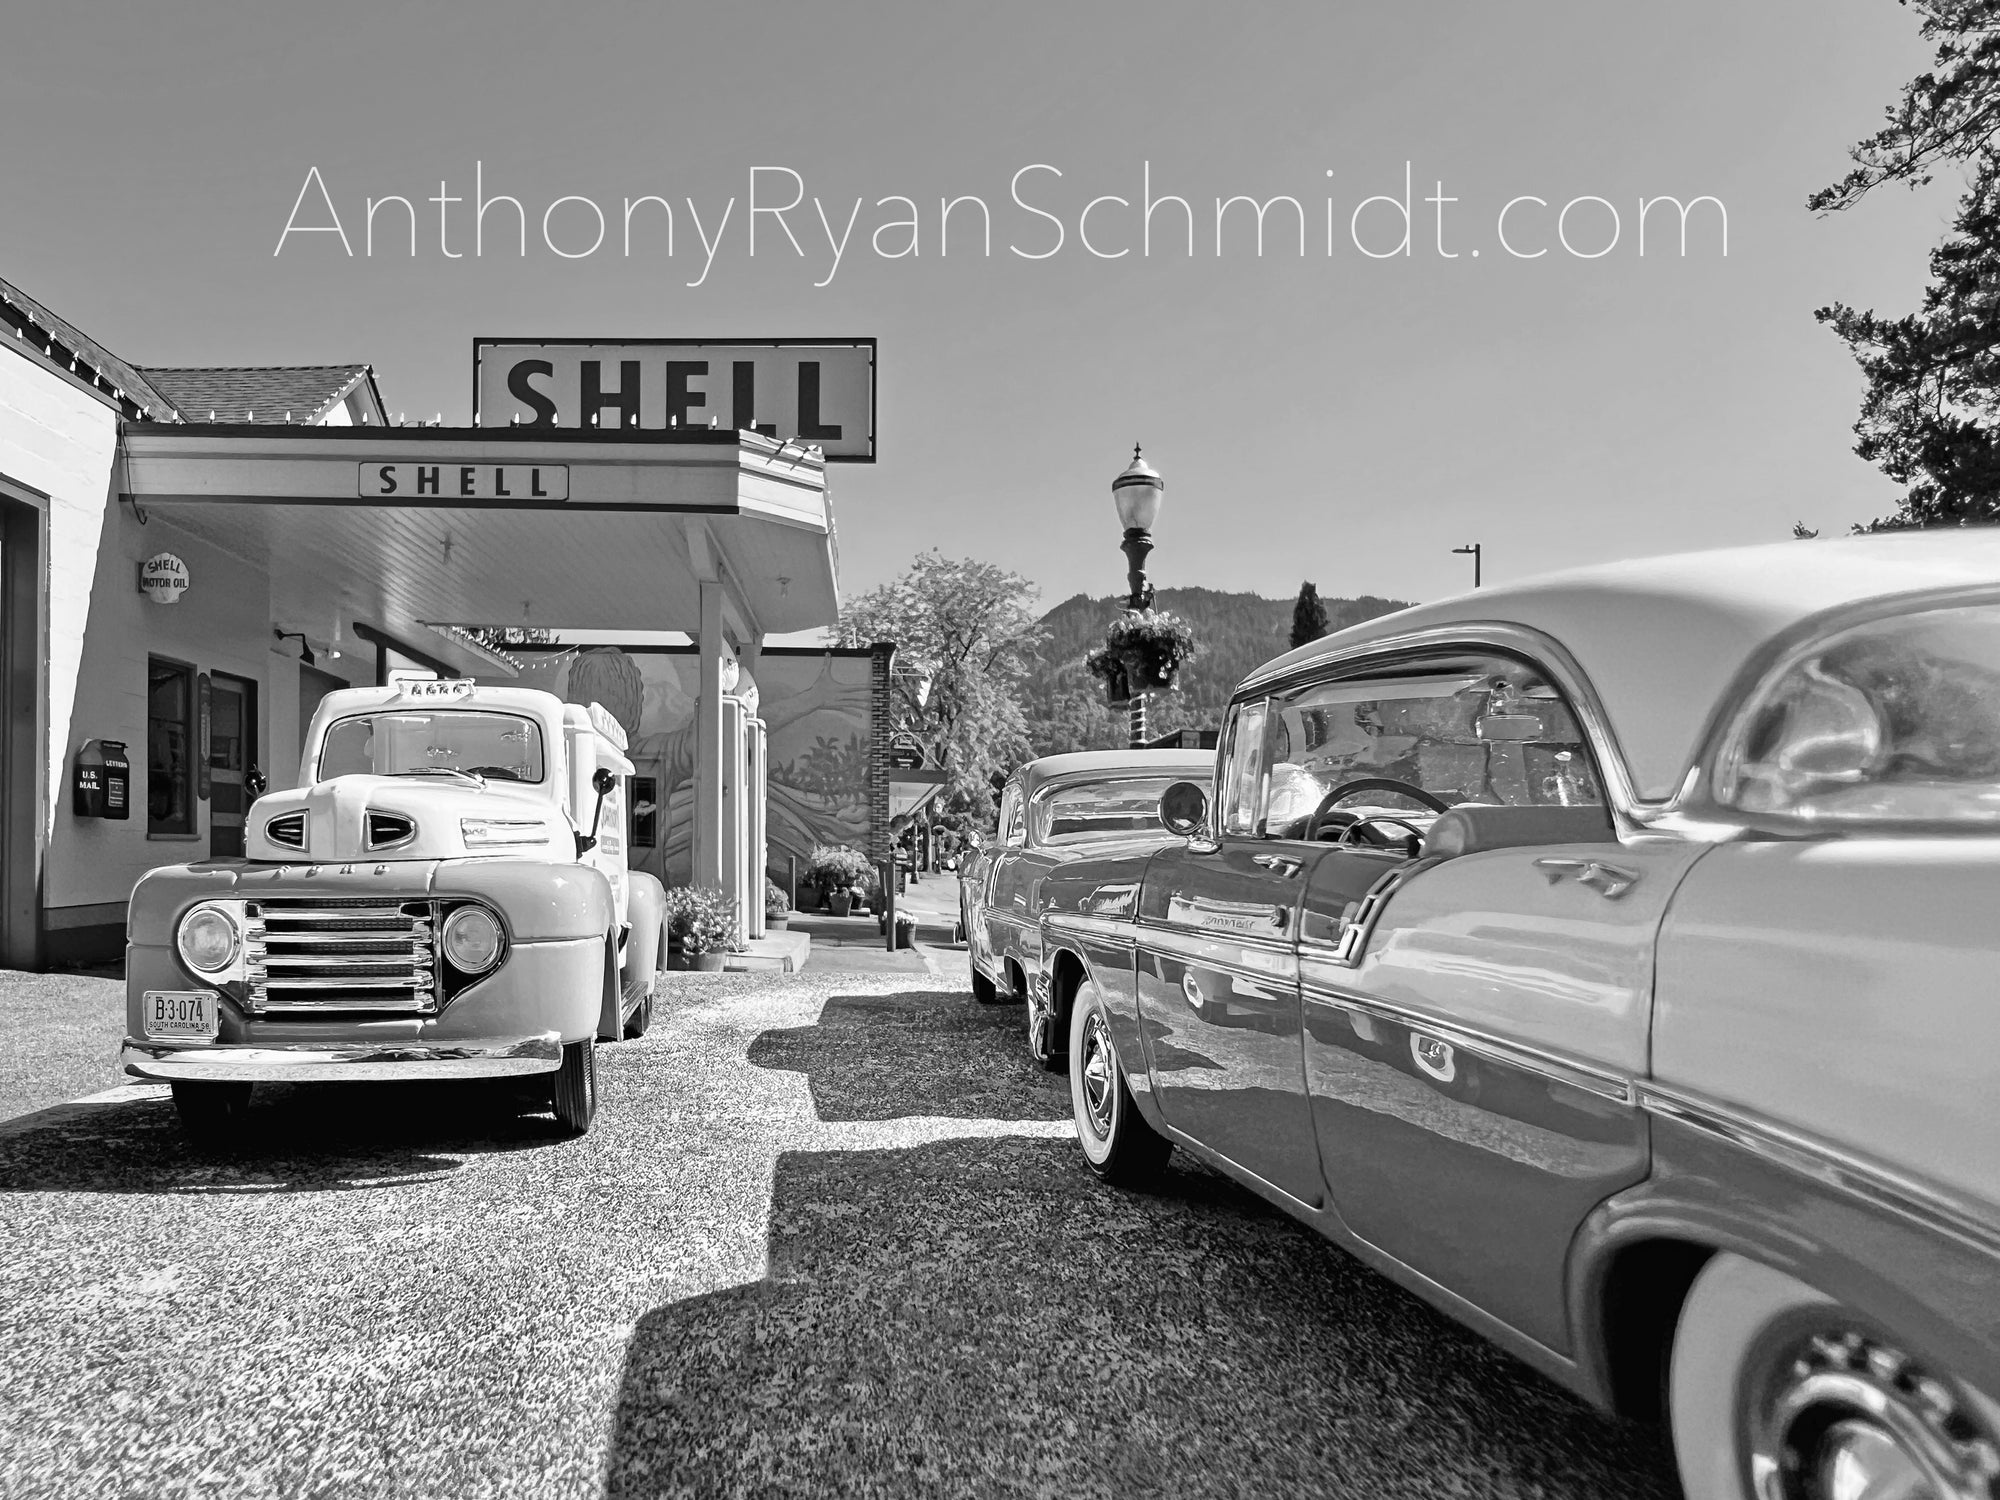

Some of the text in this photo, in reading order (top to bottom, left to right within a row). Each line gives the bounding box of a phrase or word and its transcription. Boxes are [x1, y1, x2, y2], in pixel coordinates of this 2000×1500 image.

[507, 359, 842, 441] SHELL
[379, 466, 547, 497] SHELL
[148, 559, 180, 573] SHELL
[142, 577, 188, 588] MOTOR OIL
[82, 771, 98, 780] U.S.
[79, 781, 101, 790] MAIL
[149, 1021, 169, 1029] SOUTH
[170, 1021, 199, 1030] CAROLINA
